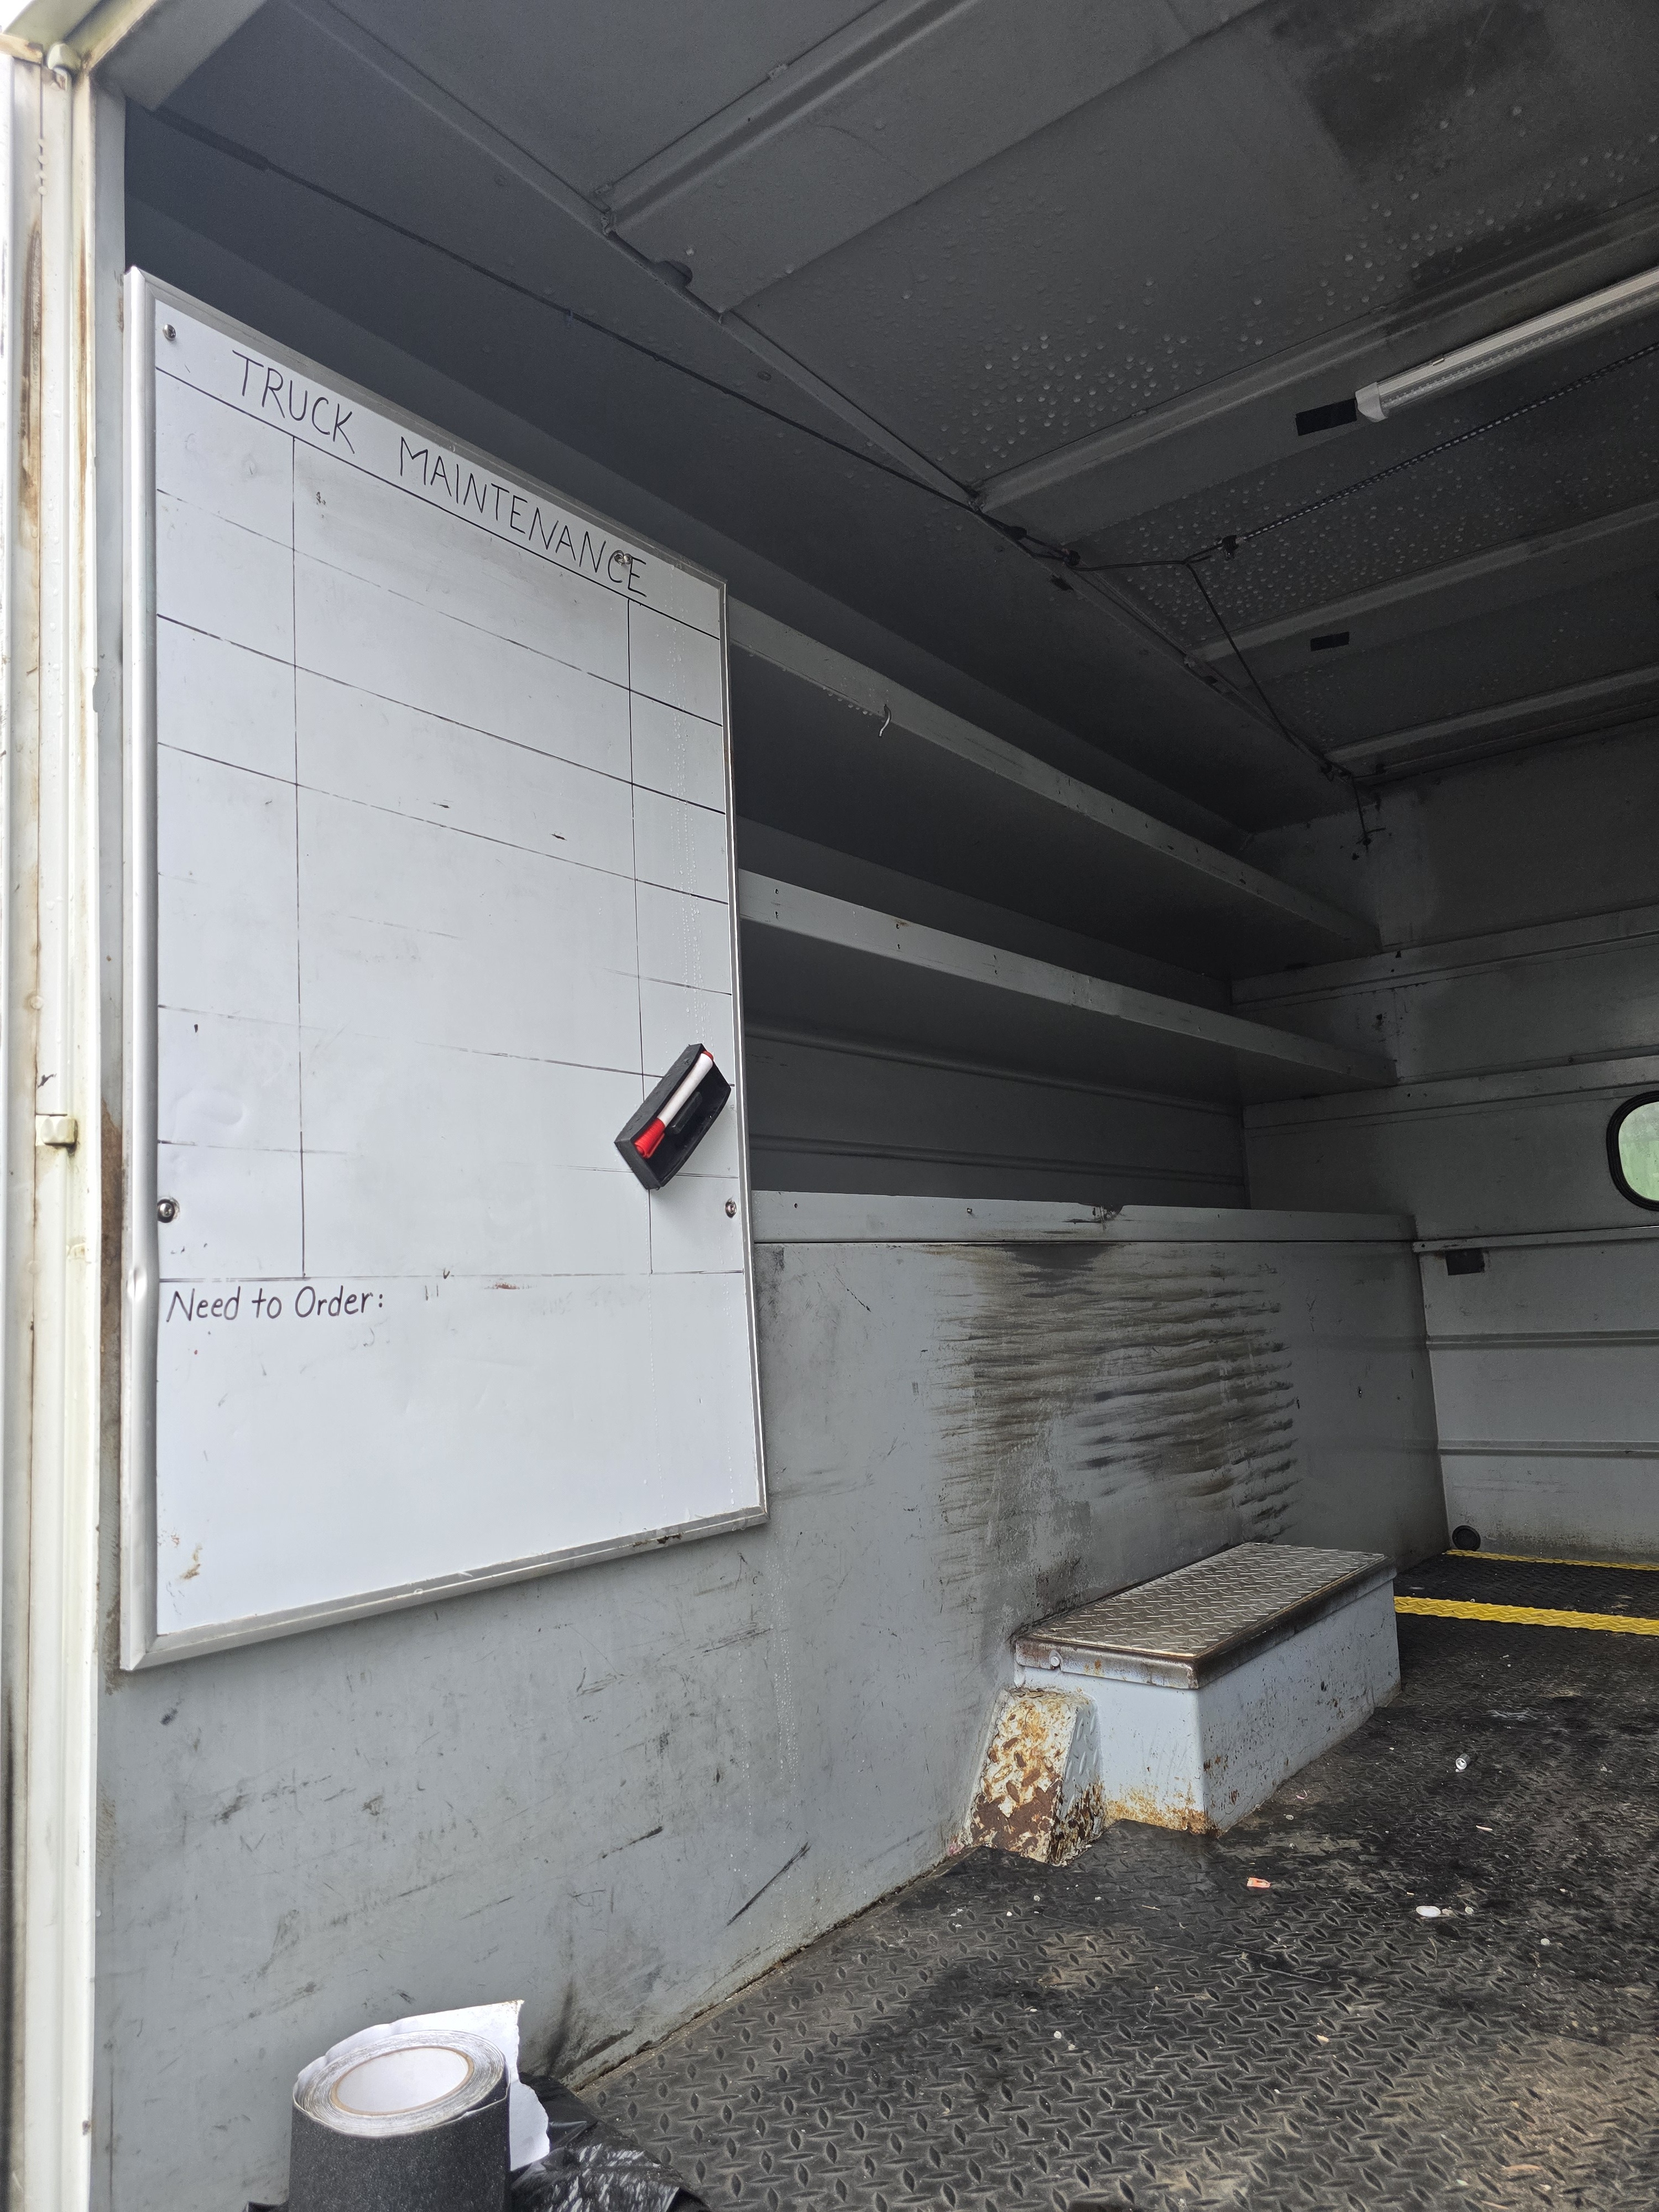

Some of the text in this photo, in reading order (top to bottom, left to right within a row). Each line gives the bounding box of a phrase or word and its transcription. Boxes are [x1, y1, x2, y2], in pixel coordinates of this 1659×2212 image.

[232, 349, 648, 597] TRUCK MAINTENANCE
[165, 1285, 383, 1322] Need to Order:
